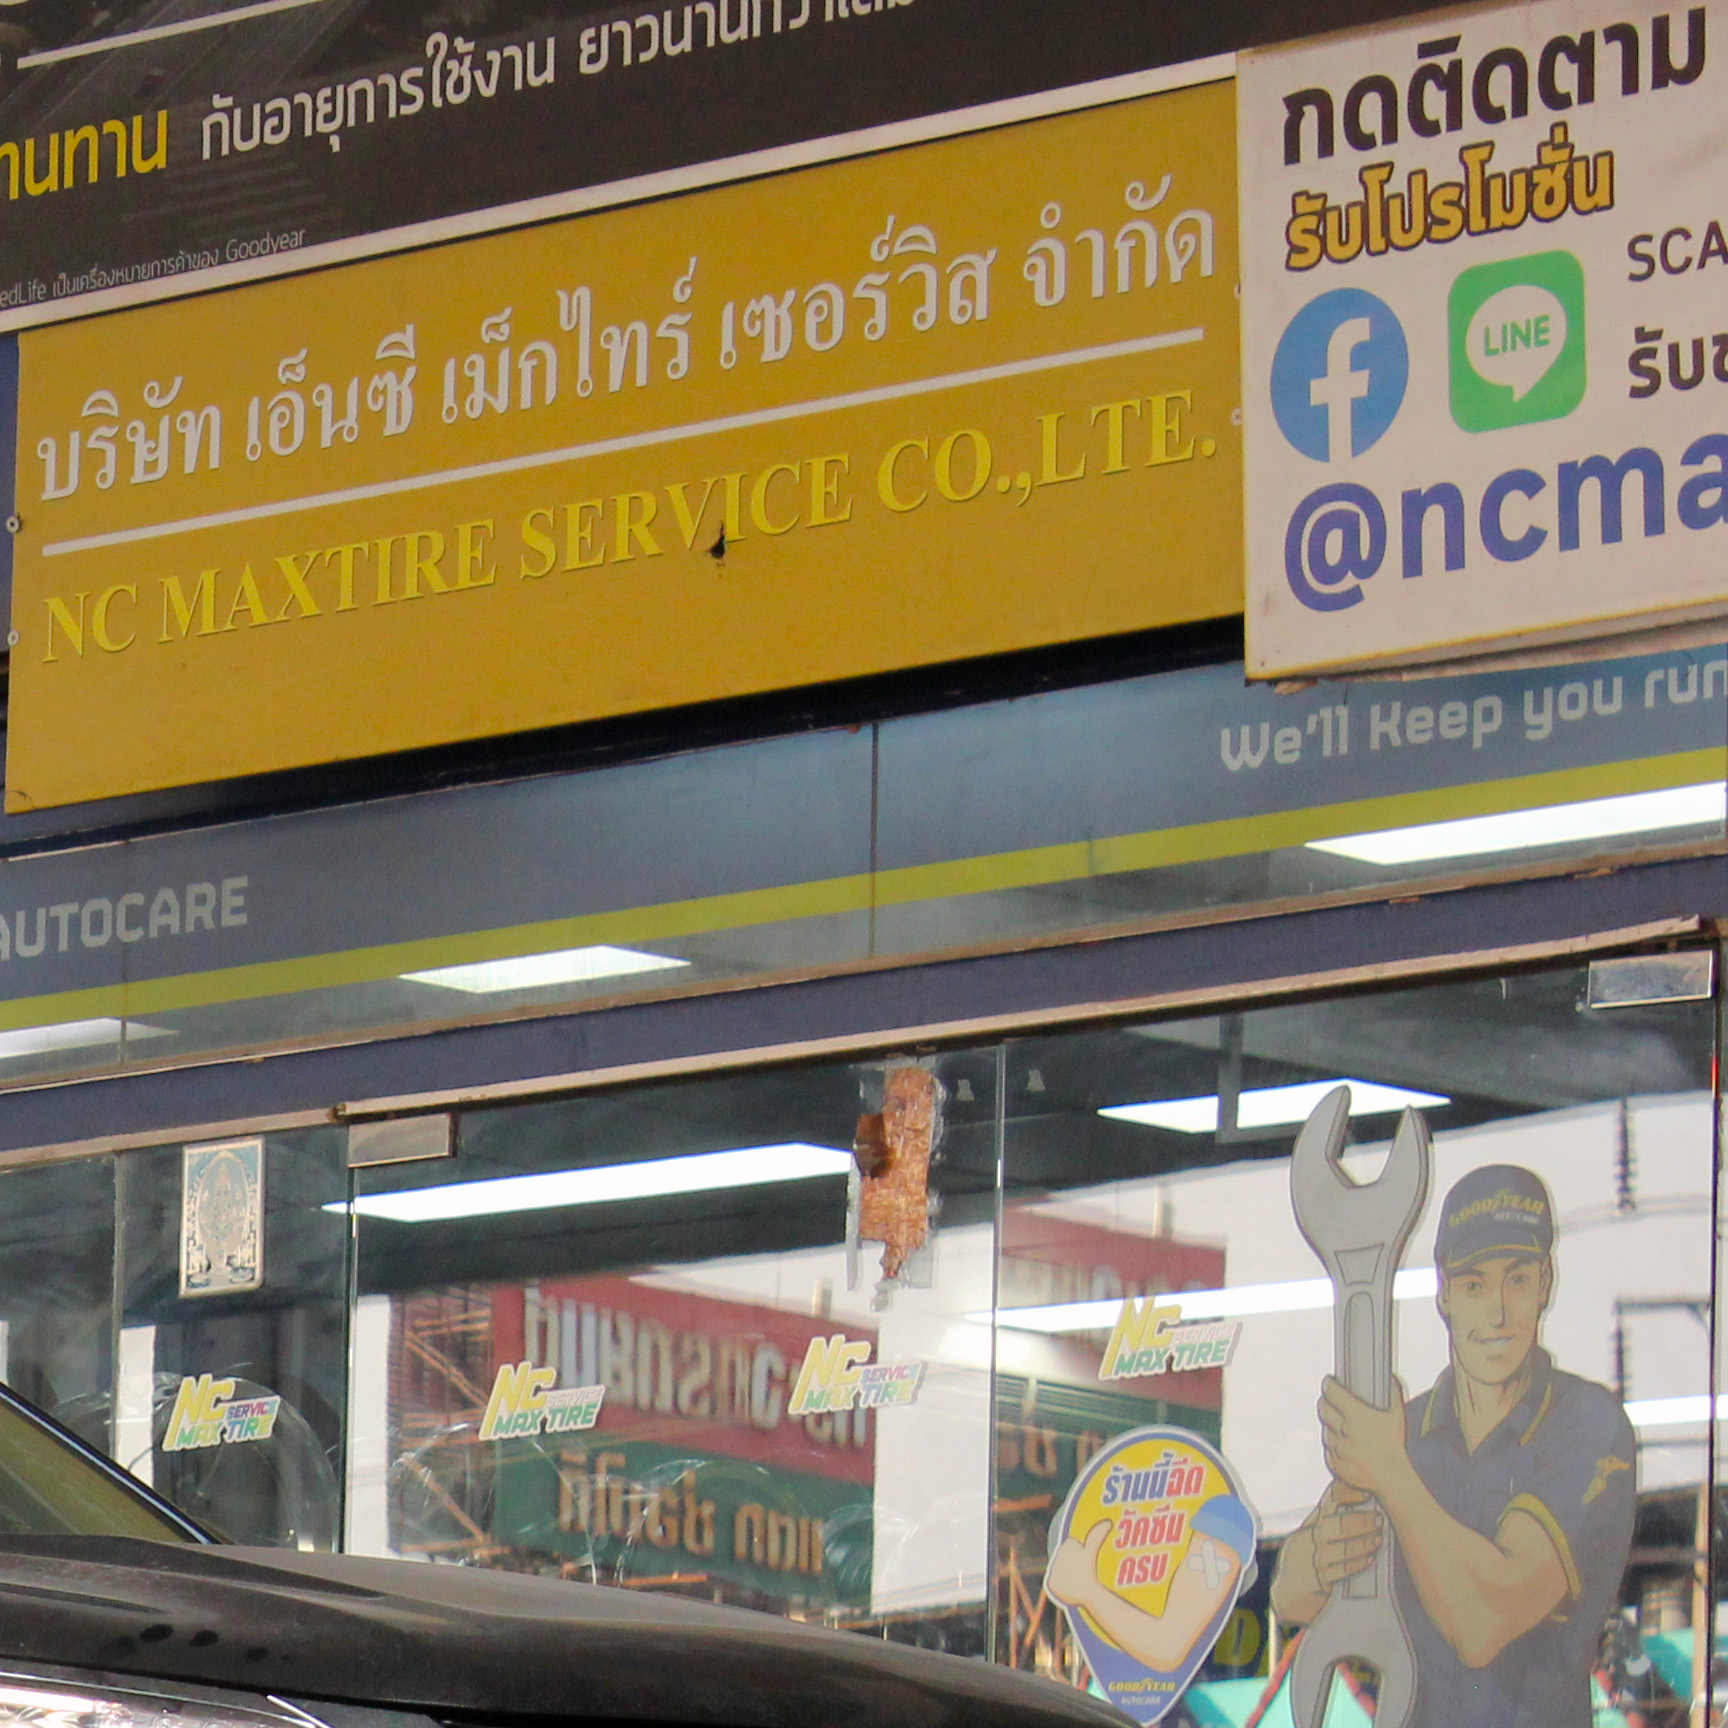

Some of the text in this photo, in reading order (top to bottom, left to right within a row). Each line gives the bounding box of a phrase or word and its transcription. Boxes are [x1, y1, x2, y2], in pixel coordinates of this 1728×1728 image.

[200, 33, 556, 160] กับอายุการใช้งาน
[1281, 6, 1707, 166] กดติดตาม
[1284, 120, 1615, 272] รับโปรโมชั่น
[226, 228, 306, 262] Goodyear
[35, 172, 1219, 506] บริษัท เอ็นซี เม็กไทร์ เซอร์วิส จำกัด
[1483, 313, 1552, 358] LINE
[40, 583, 140, 664] NC
[157, 515, 498, 648] MAXTIRE
[519, 454, 854, 582] SERVICE
[1220, 705, 1350, 772] We'll
[1370, 694, 1503, 750] Keep
[1523, 676, 1623, 741] you
[1102, 1297, 1181, 1377] NC
[1114, 1341, 1229, 1376] MAX TIRE
[481, 1363, 554, 1438] NC
[790, 1335, 869, 1412] NC
[803, 1381, 915, 1410] MAX TIRE
[165, 1376, 277, 1447] NC SERVICE
[176, 1415, 272, 1447] MAX TIRE
[493, 1404, 597, 1436] MAX TIRE
[1103, 1452, 1204, 1505] ร้านนี้ฉีด
[1115, 1506, 1185, 1549] วัคซีน
[1117, 1553, 1168, 1585] ครบ
